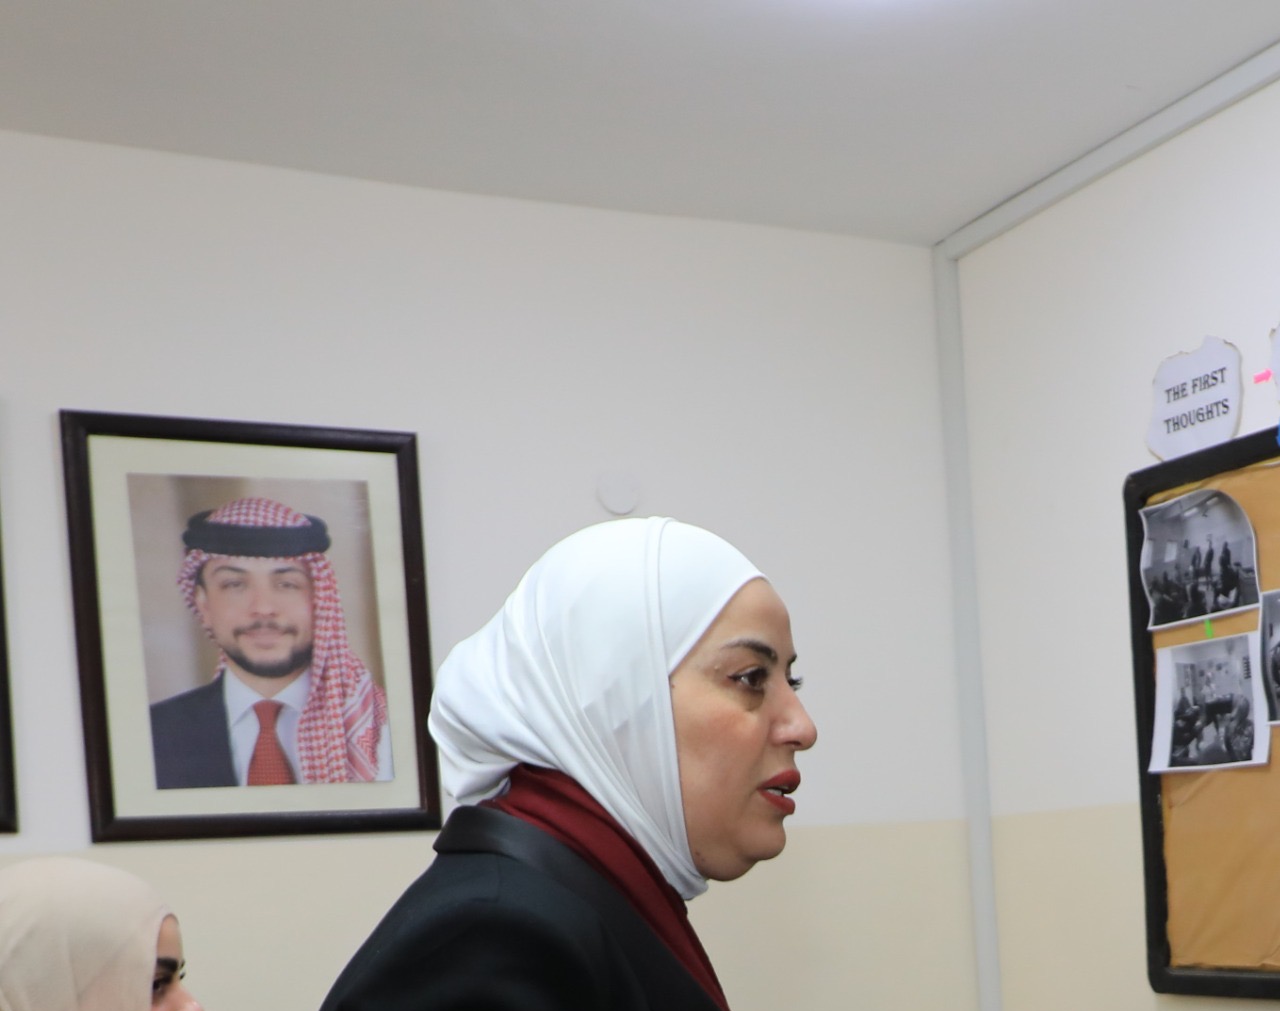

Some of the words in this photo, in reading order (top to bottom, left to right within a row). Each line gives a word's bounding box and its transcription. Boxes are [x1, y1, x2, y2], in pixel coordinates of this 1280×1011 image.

[1165, 379, 1188, 403] THE
[1192, 367, 1227, 394] FIRST
[1164, 399, 1229, 434] THOUGHTS
